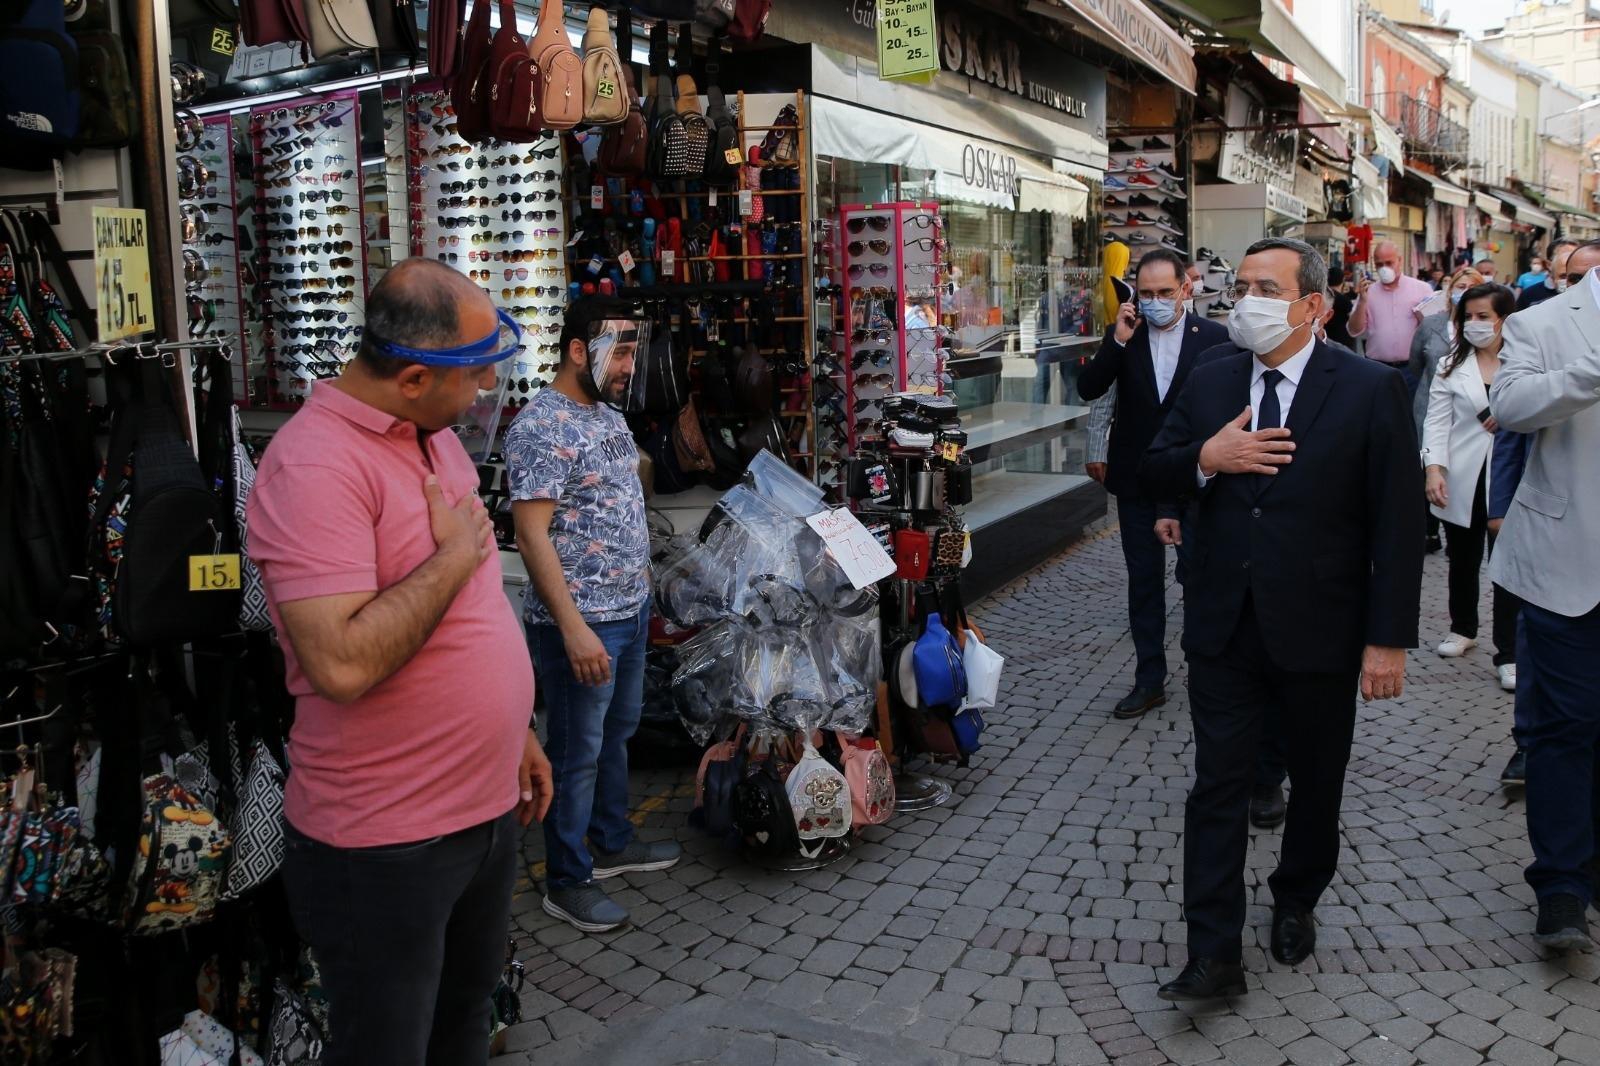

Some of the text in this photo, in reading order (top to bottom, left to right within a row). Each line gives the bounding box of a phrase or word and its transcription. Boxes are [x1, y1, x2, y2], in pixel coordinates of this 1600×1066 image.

[906, 2, 928, 13] BAYAN
[213, 32, 233, 51] 25
[938, 8, 1087, 118] SKAR KUYUMCULUK
[599, 82, 614, 96] 25
[962, 144, 1019, 197] OSKAR
[102, 258, 125, 332] 15
